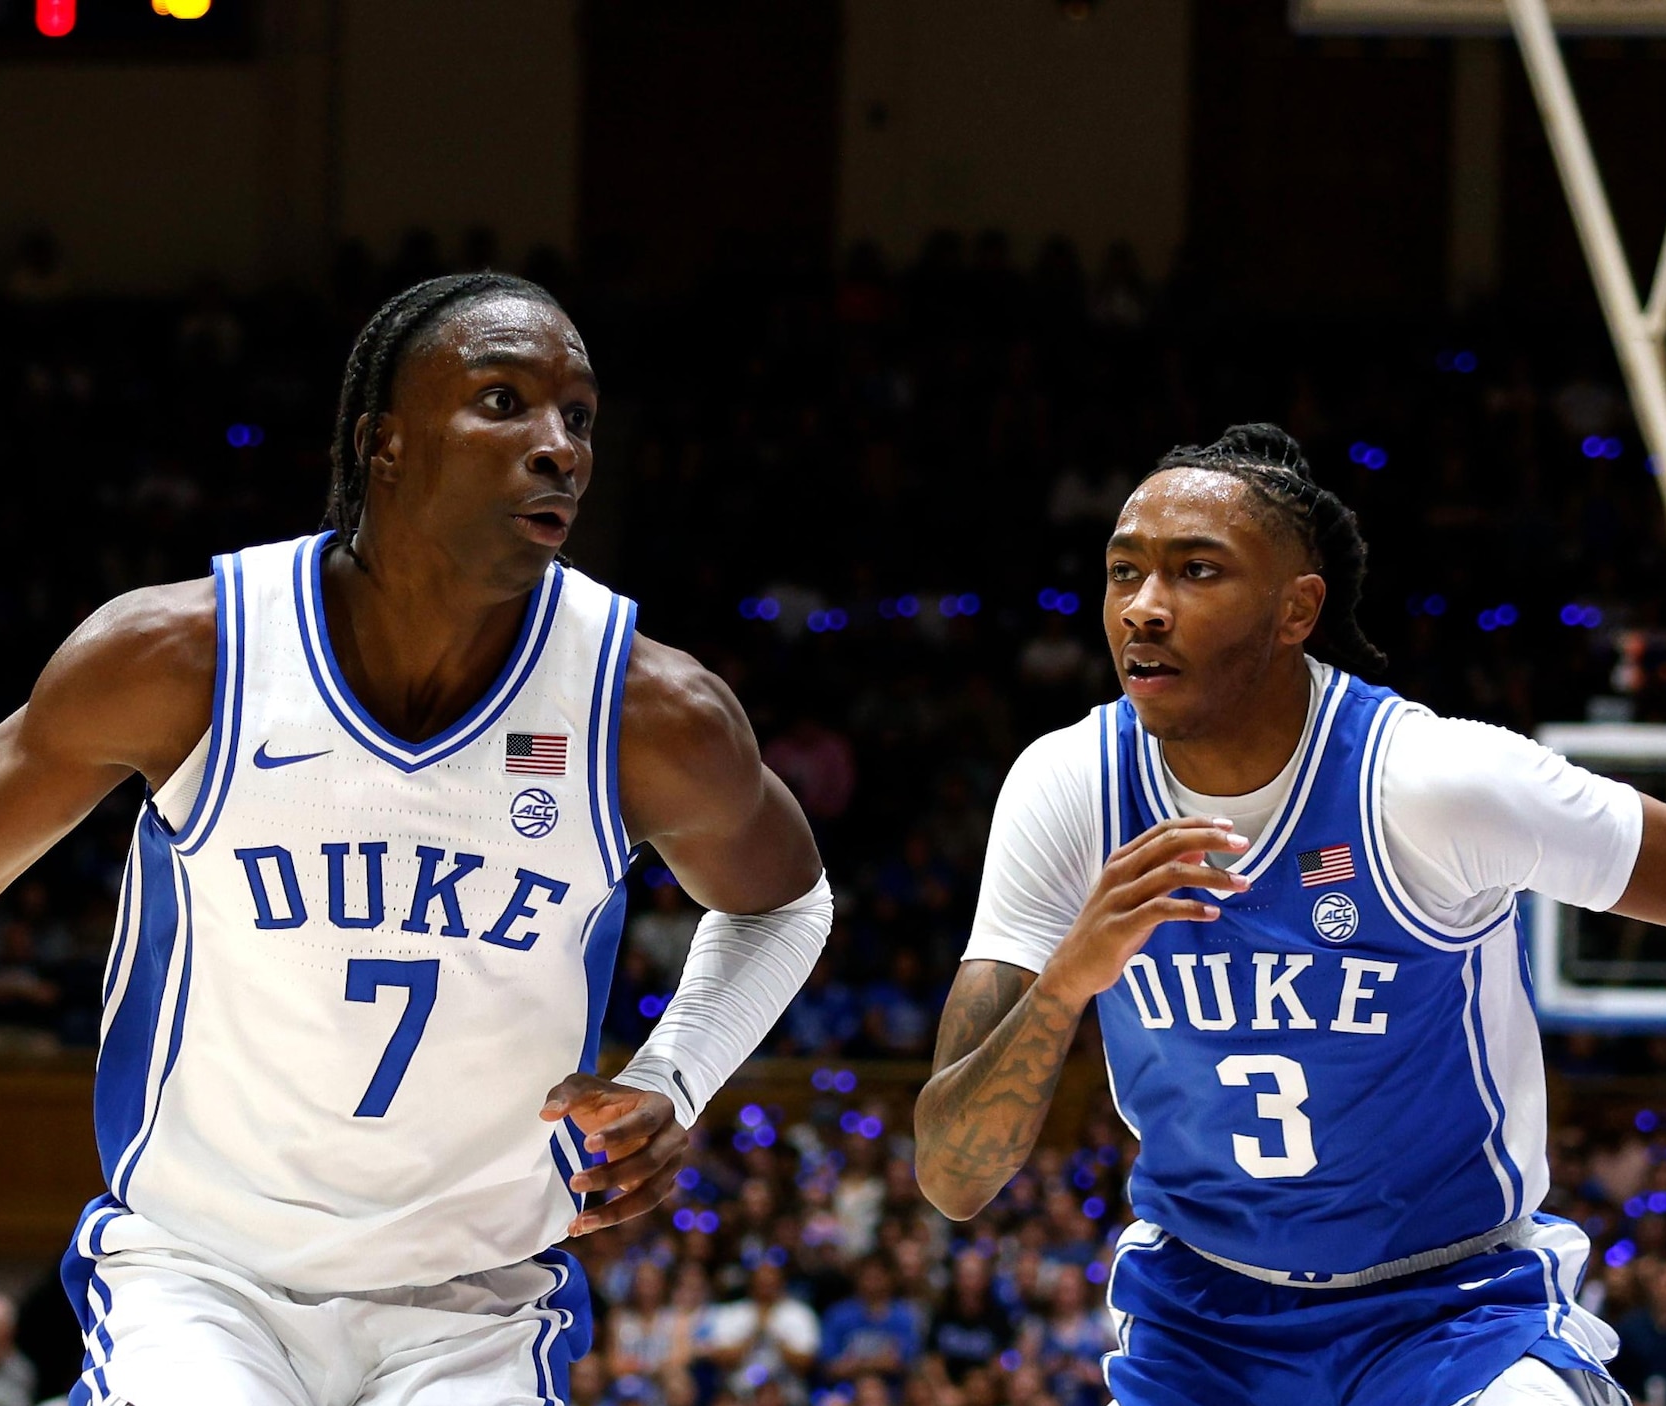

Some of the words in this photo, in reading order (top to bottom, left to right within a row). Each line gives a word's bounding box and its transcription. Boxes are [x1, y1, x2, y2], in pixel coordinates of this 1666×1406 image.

[517, 804, 556, 816] ACC
[233, 842, 570, 951] DUKE
[1320, 906, 1353, 921] ACC
[345, 959, 440, 1117] 7
[1123, 952, 1398, 1035] DUKE
[1215, 1054, 1318, 1179] 3
